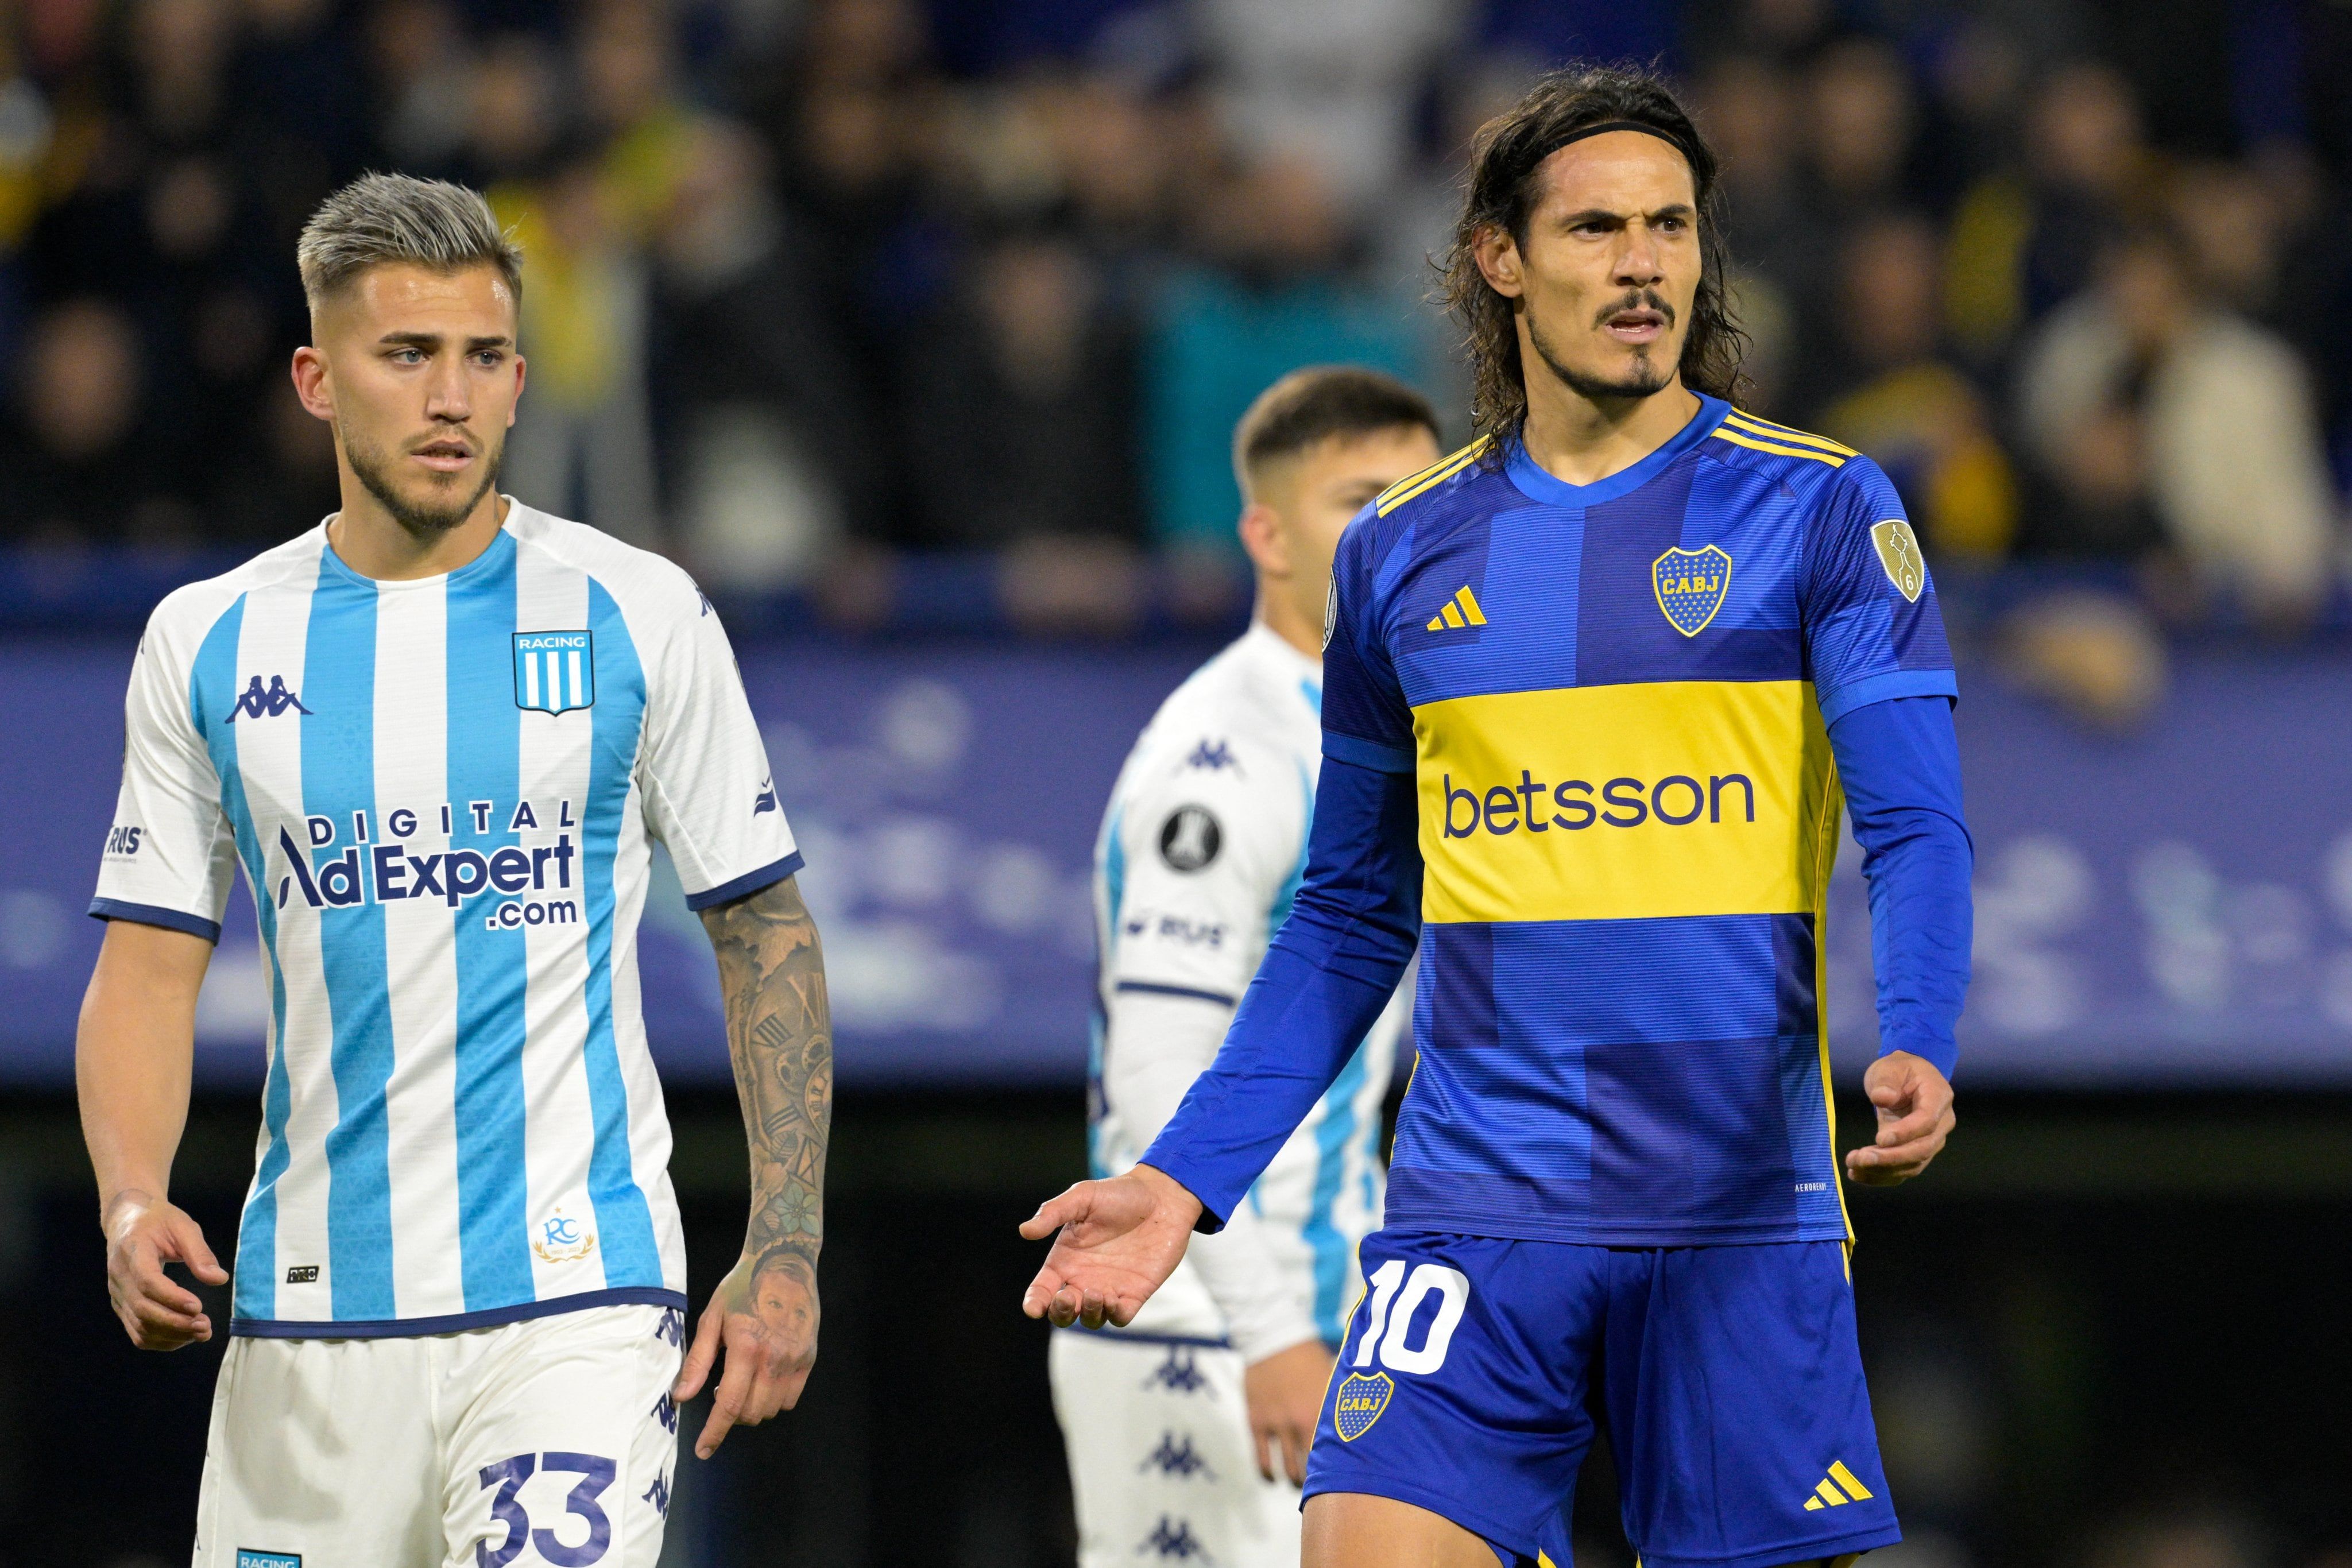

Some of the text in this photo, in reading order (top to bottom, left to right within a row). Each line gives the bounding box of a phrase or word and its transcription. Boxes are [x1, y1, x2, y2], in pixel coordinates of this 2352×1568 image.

[1662, 575, 1719, 595] CABJ
[519, 637, 586, 650] RACING
[1443, 769, 1755, 839] betsson
[307, 800, 575, 845] DIGITAL
[1352, 1260, 1470, 1375] 10
[1340, 1397, 1382, 1411] CABJ
[476, 1451, 617, 1568] 33
[241, 1557, 295, 1568] RACING
